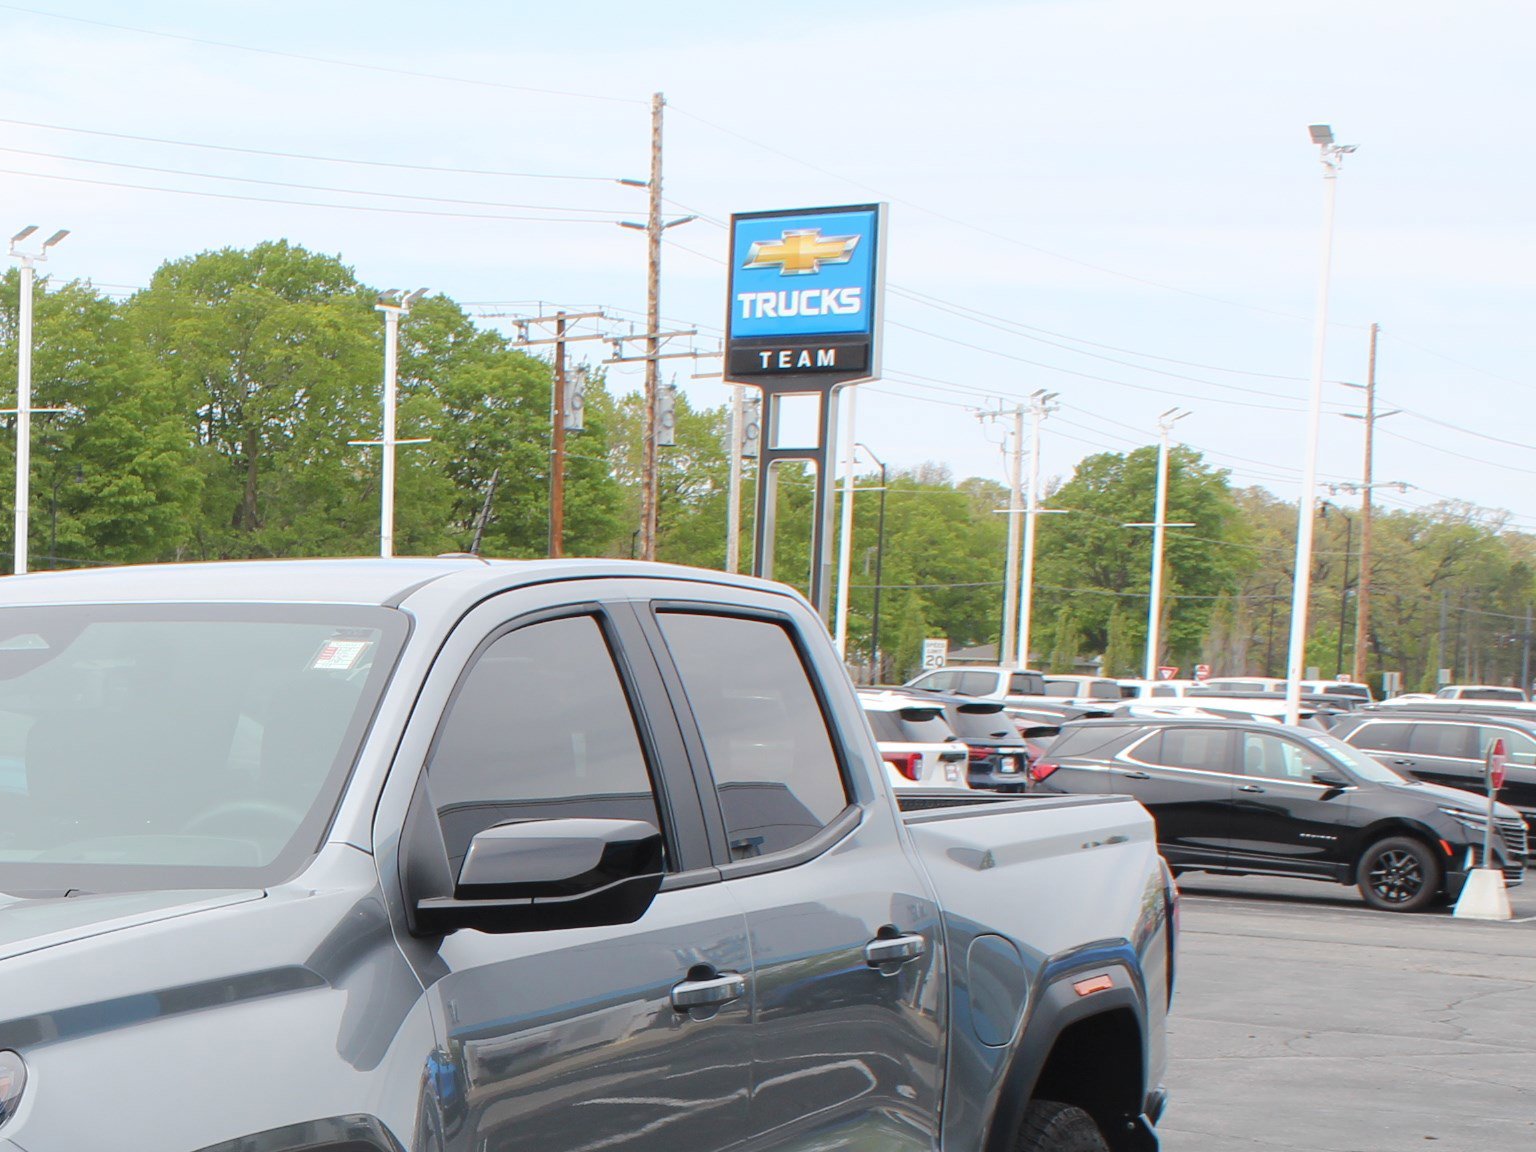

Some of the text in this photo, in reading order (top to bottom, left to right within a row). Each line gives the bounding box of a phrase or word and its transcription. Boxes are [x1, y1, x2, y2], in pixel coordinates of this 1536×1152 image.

[737, 287, 862, 319] TRUCKS
[759, 348, 836, 369] TEAM
[925, 654, 945, 667] 20
